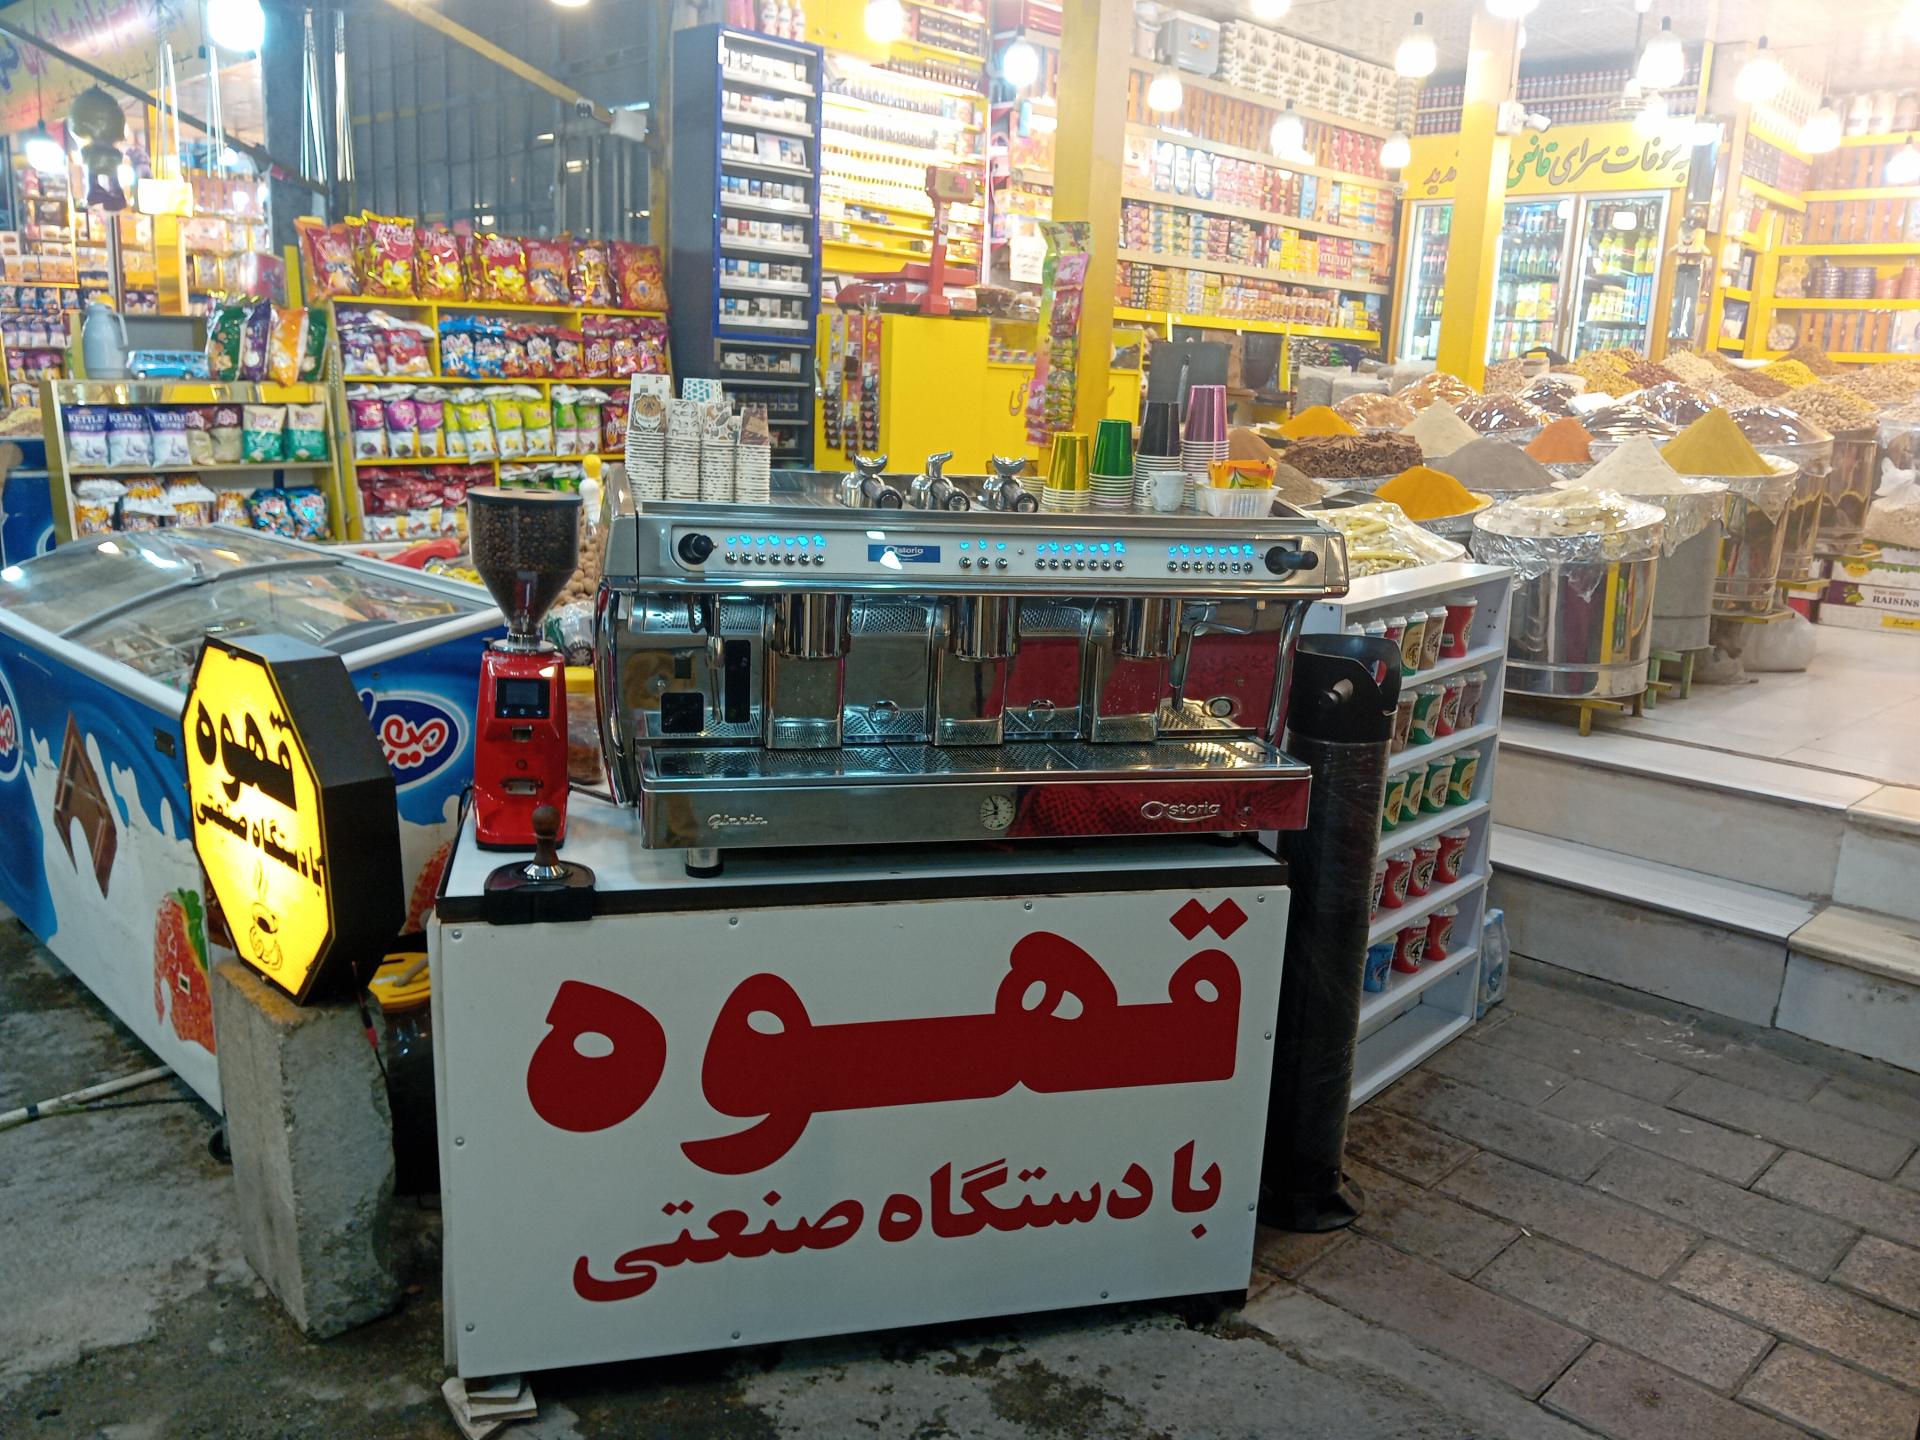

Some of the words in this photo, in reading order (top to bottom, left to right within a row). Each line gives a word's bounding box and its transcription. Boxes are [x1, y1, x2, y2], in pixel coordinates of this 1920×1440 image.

[1548, 136, 1611, 186] سرای
[1600, 135, 1683, 174] سوغات
[1872, 595, 1920, 608] RAISINS
[195, 698, 297, 812] قهوه
[194, 793, 247, 842] صنعتی
[1140, 800, 1221, 822] Astoria
[252, 817, 308, 879] دستگاه
[527, 896, 1248, 1175] قهوه
[879, 1158, 1154, 1243] دستگاه
[1172, 1140, 1221, 1240] با
[574, 1190, 865, 1302] صنعتی
